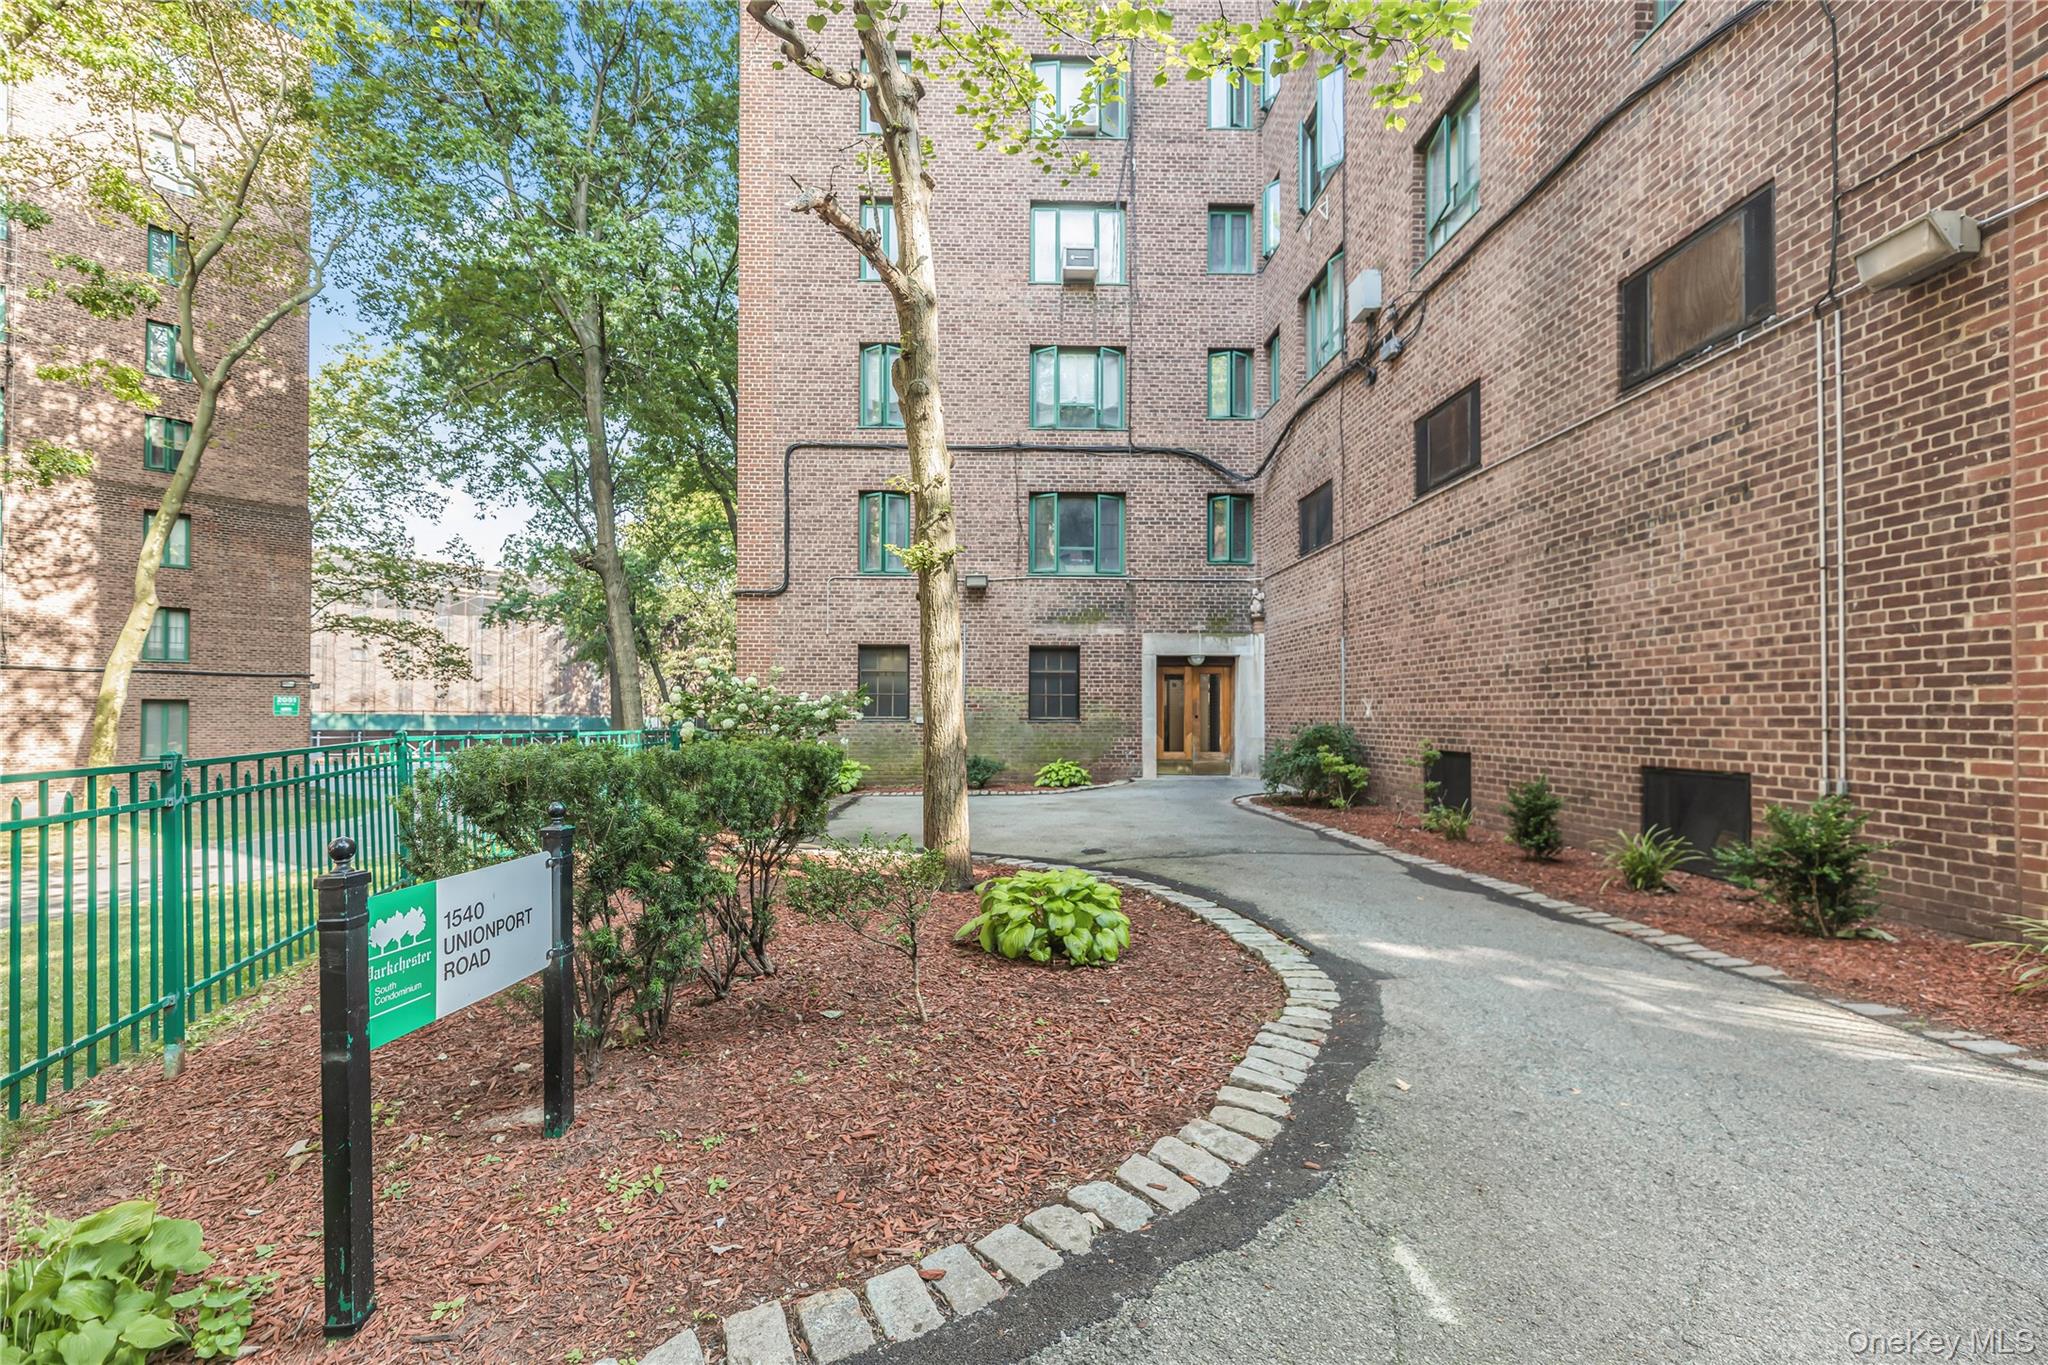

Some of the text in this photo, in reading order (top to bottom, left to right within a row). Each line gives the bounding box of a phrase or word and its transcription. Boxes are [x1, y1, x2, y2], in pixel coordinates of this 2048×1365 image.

[444, 901, 485, 930] 1540
[444, 907, 533, 955] UNIONPORT
[444, 948, 491, 981] ROAD
[374, 982, 397, 996] South
[374, 982, 422, 1006] Condominium
